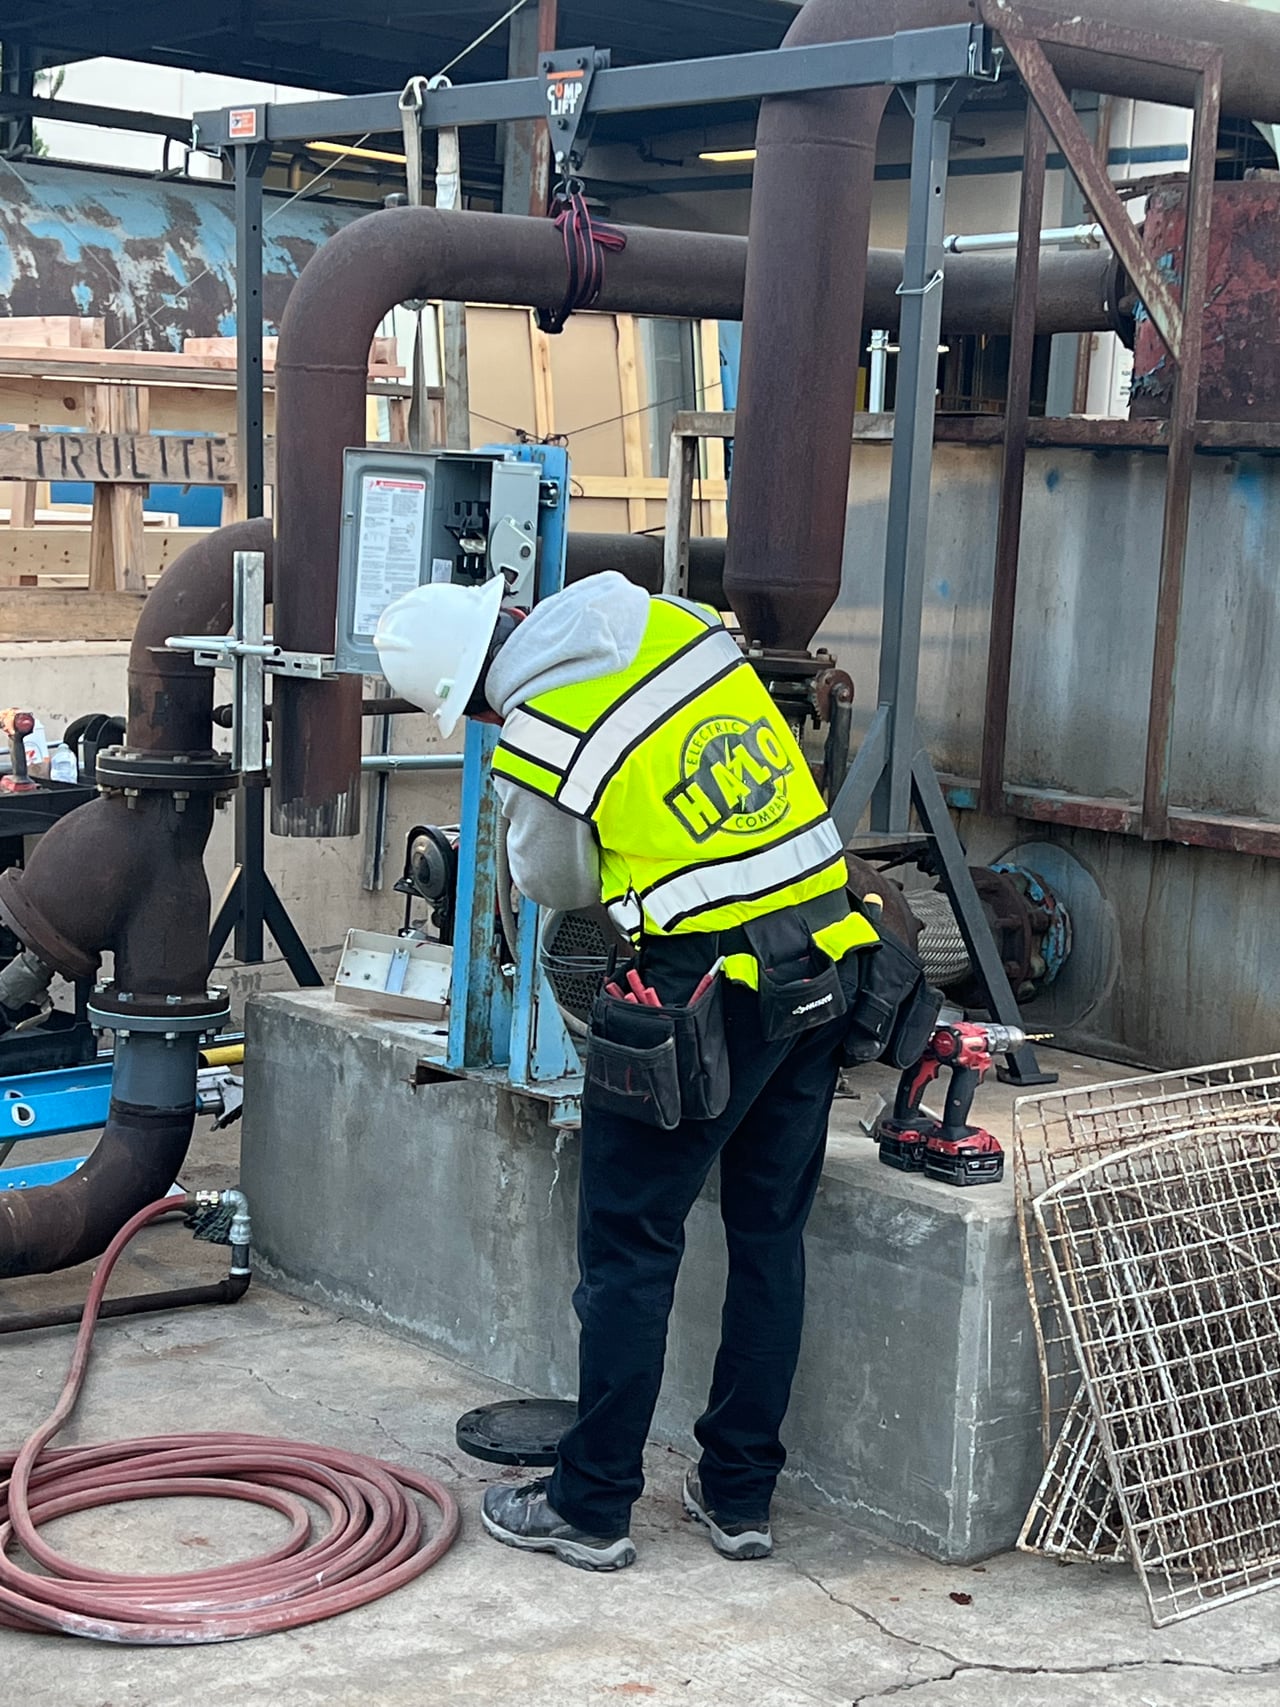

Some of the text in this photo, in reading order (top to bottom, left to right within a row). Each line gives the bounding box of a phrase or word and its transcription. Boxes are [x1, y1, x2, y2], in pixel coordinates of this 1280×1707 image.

[547, 82, 583, 101] COMP
[551, 99, 577, 115] LIFT
[28, 434, 230, 480] TRULITE
[686, 721, 740, 766] ELECTRIC
[672, 726, 789, 835] HALO
[735, 794, 787, 829] COMPAN
